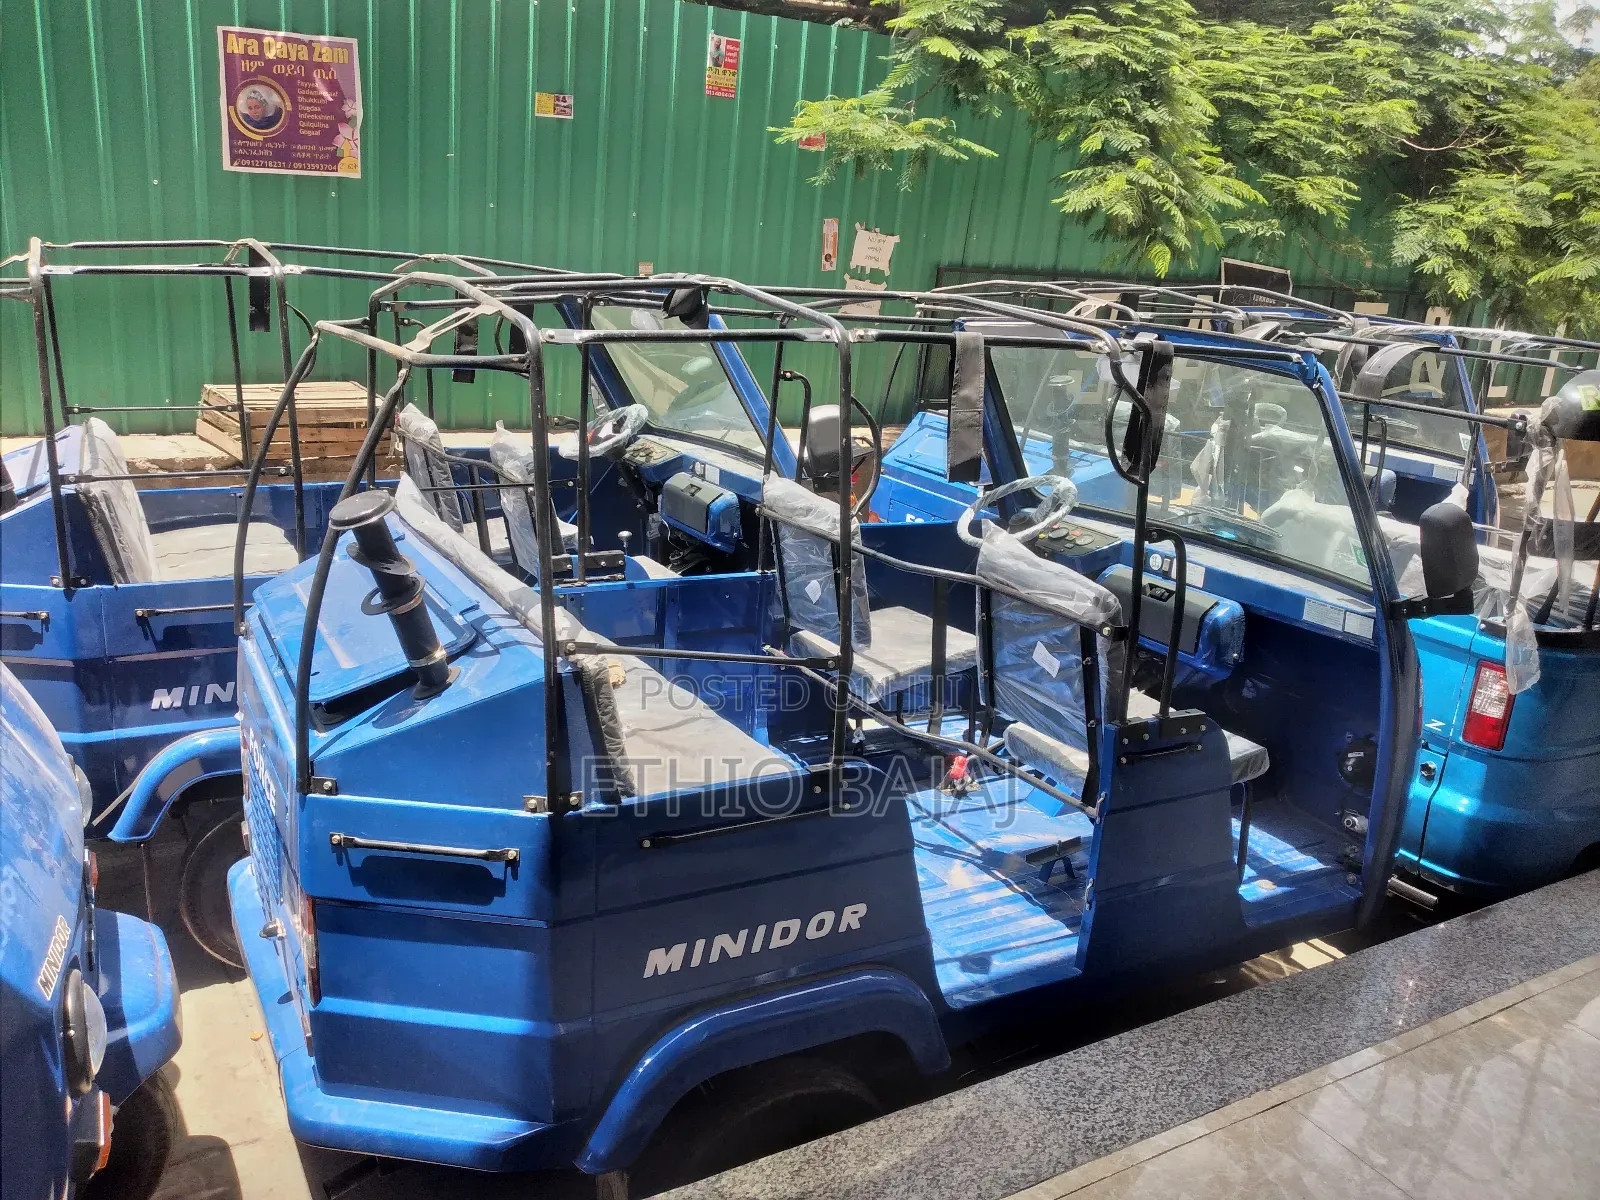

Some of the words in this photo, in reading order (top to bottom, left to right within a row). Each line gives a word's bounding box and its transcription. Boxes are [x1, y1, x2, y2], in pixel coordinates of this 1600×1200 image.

[226, 33, 259, 56] Ara
[263, 36, 309, 61] Qaya
[312, 42, 349, 64] Zam
[241, 160, 286, 169] 0912718231
[293, 162, 337, 171] 0913593704
[151, 681, 235, 710] MIN
[642, 902, 868, 979] MINIDOR
[38, 914, 71, 1001] MINIDOR
